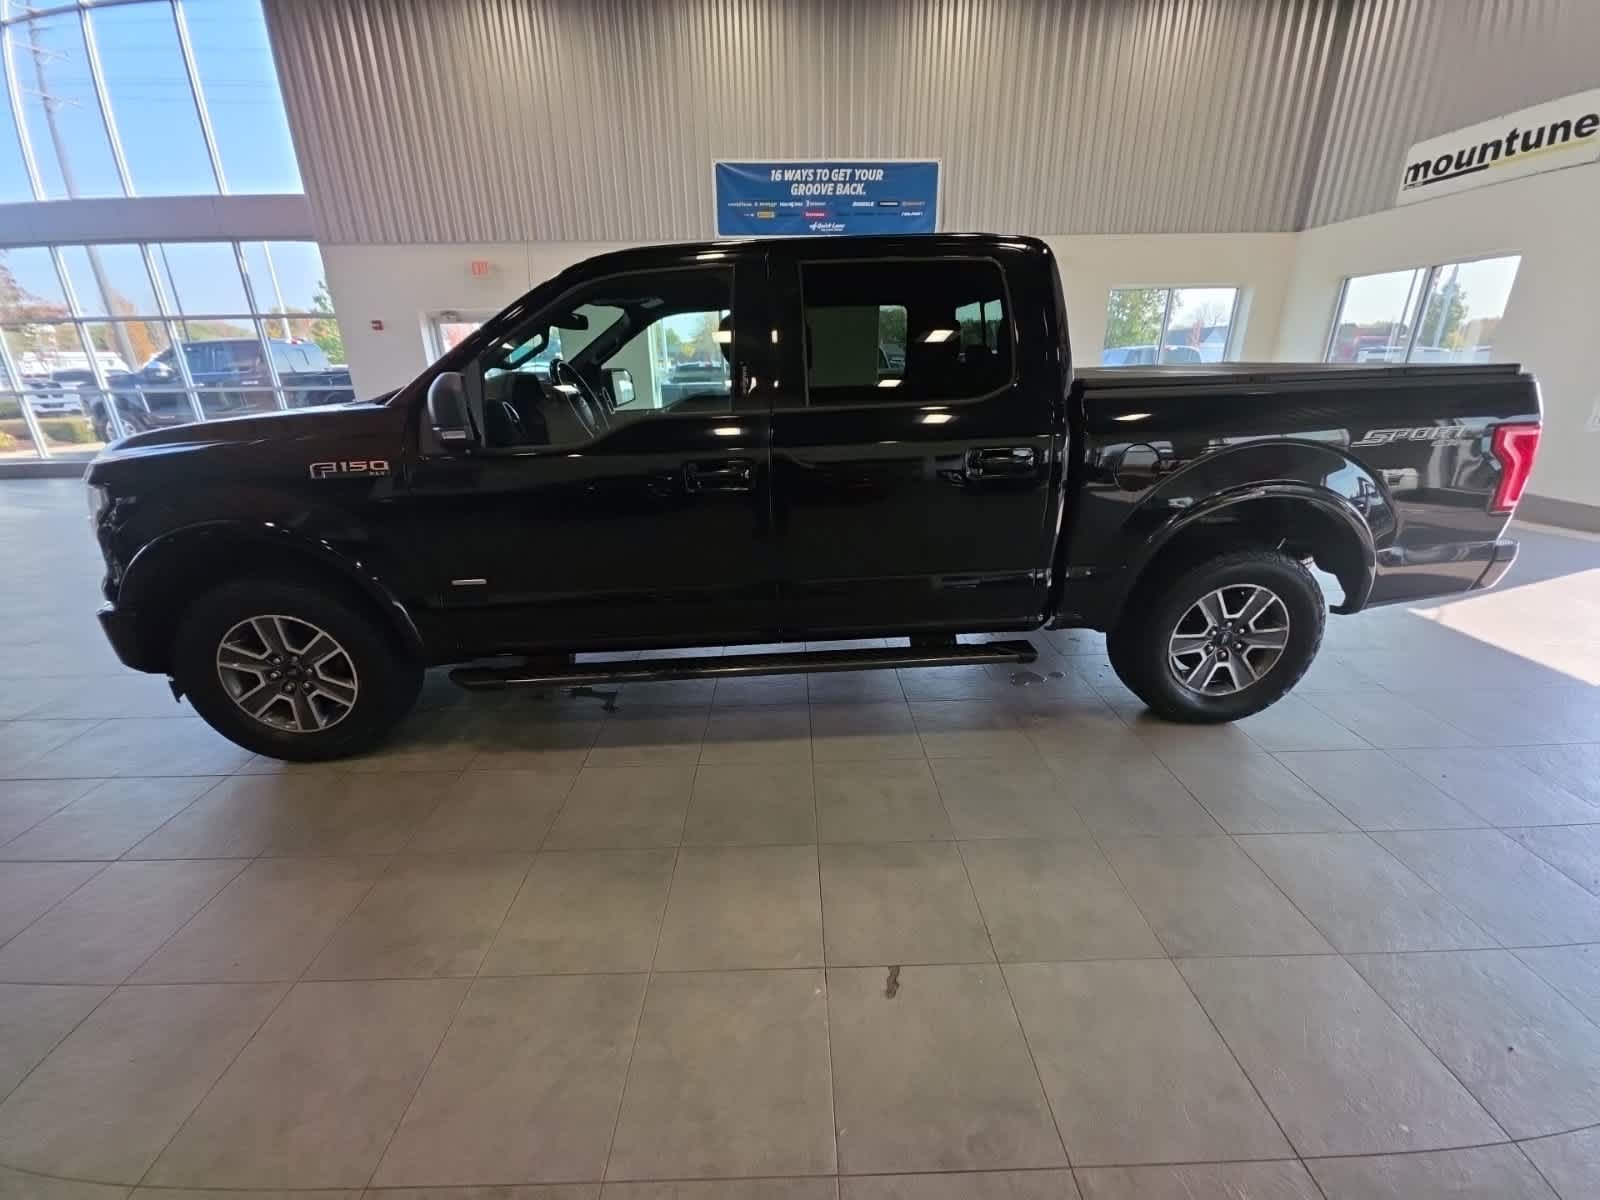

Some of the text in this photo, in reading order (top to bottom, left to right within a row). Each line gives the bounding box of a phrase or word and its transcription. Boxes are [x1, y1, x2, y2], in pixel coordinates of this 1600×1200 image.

[1404, 113, 1600, 185] mountune
[770, 169, 884, 181] 16 WAYS TO GET YOUR
[791, 183, 866, 195] GROOVE BACK.
[1351, 426, 1465, 447] SPORT
